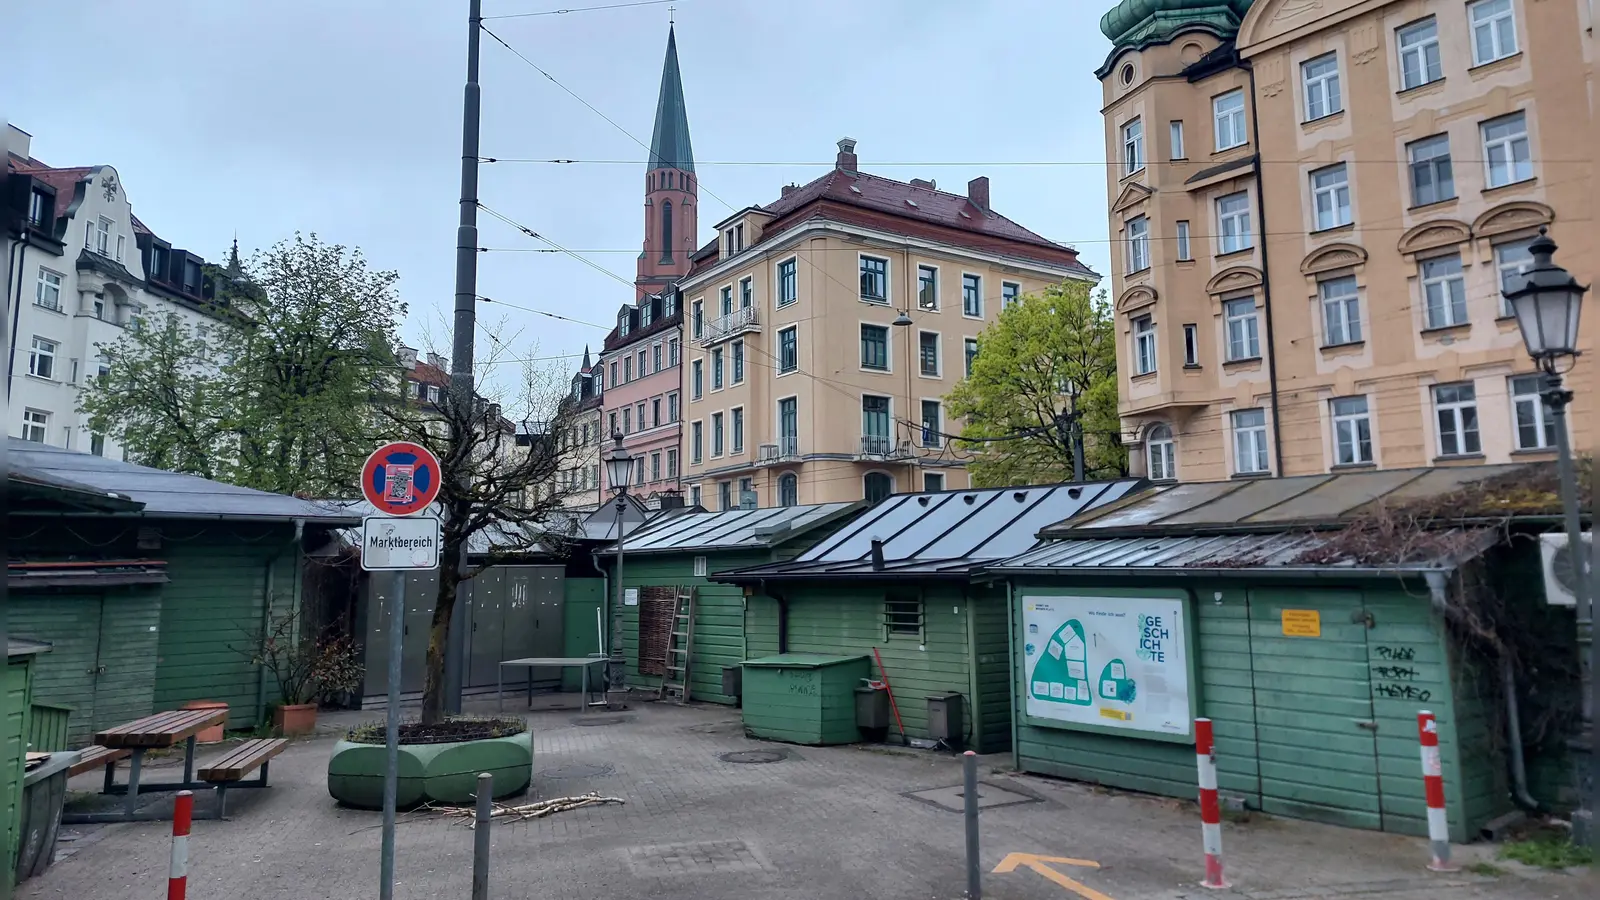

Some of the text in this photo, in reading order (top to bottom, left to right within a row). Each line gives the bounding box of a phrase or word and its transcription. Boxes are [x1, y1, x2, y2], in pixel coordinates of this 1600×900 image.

[370, 536, 432, 548] Marktbereich
[1145, 616, 1162, 627] GE
[1143, 627, 1169, 639] SCH
[1140, 638, 1161, 650] ICH
[1150, 651, 1165, 662] TE
